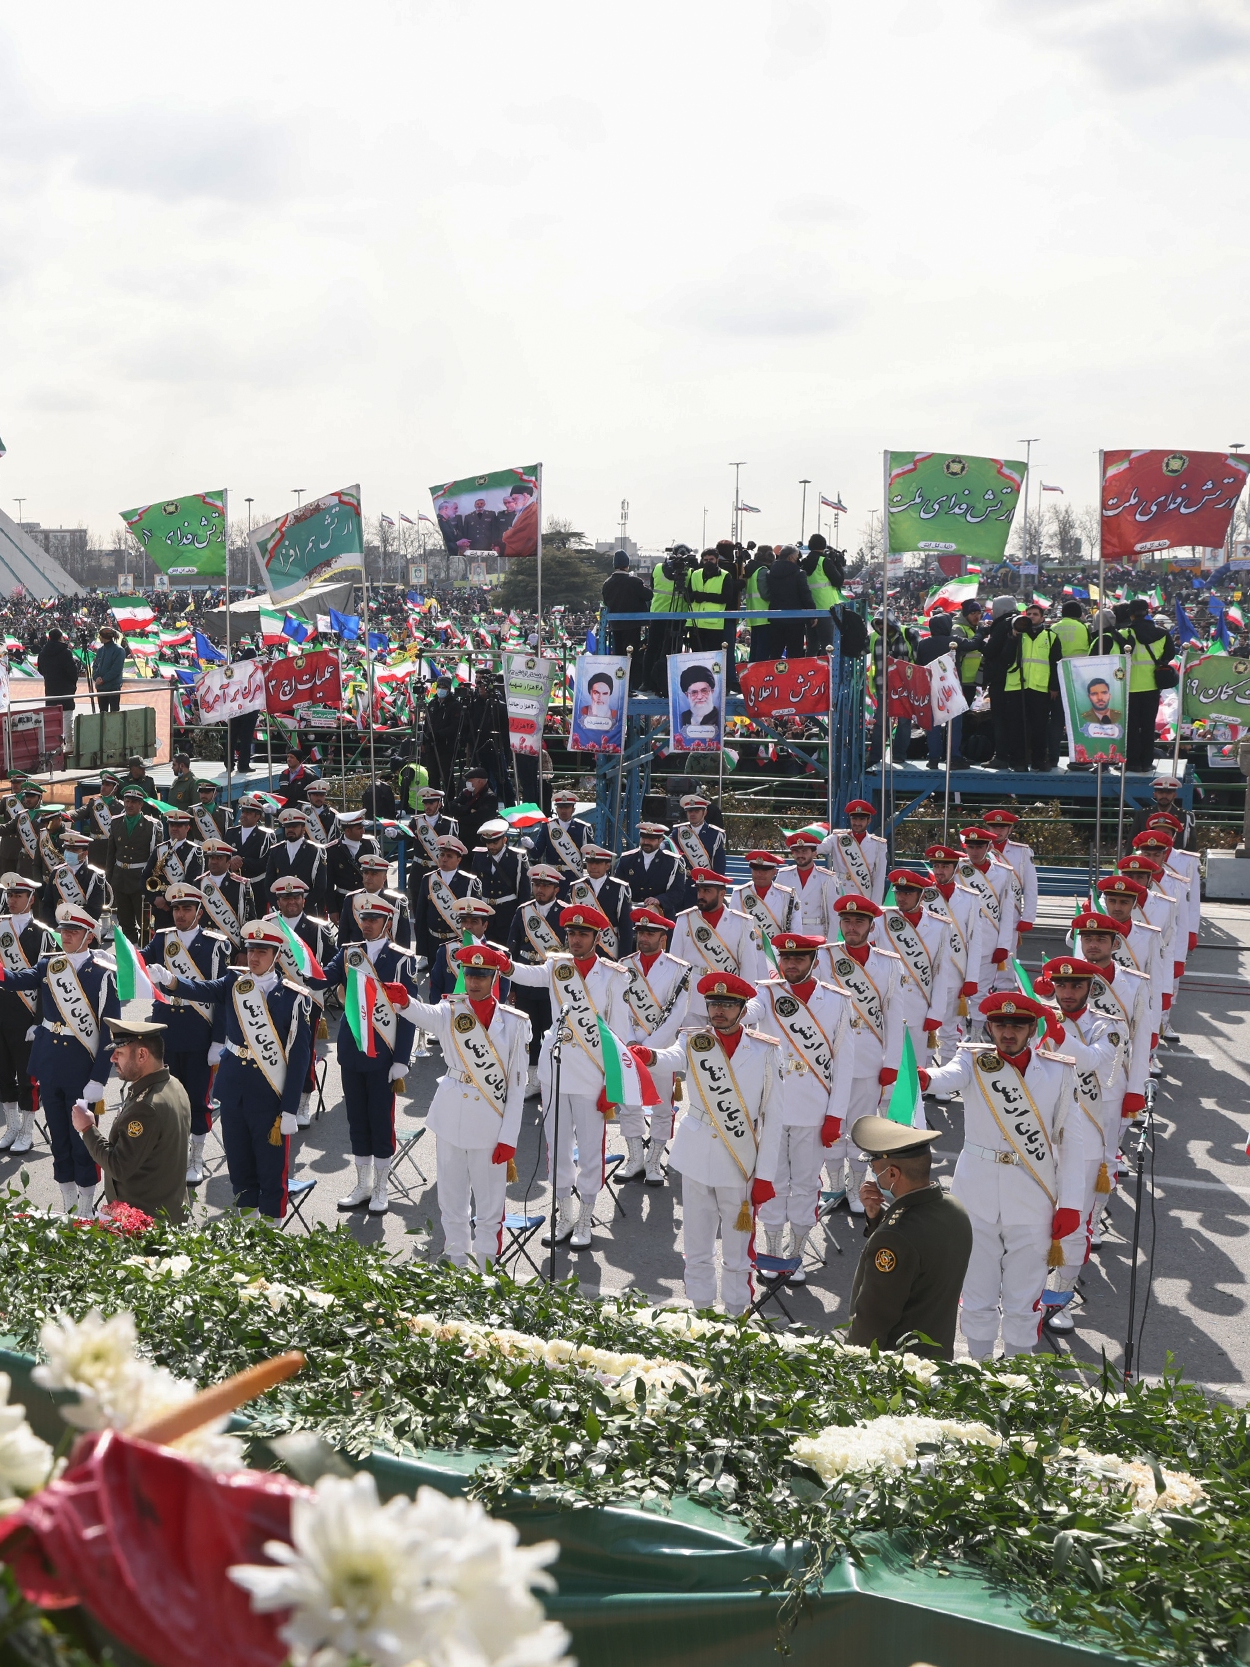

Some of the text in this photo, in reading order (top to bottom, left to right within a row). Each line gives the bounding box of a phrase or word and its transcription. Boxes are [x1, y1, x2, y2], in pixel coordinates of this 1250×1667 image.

[887, 486, 1016, 524] ارتش فدای ملت
[1102, 477, 1241, 522] ارتش فدای ملت
[194, 512, 226, 549] ارتش
[319, 506, 353, 550] ارتش
[279, 675, 296, 701] اچ
[297, 665, 335, 699] عملیات
[747, 670, 826, 711] ارتش انقلابی
[845, 849, 870, 890] دژبان ارتش
[970, 880, 994, 900] ارتش
[208, 897, 228, 918] ارتش
[704, 942, 728, 964] ارتش
[897, 933, 923, 957] ارتش
[57, 977, 93, 1038] دژبان ارتش
[629, 986, 658, 1016] ارتش
[845, 977, 878, 1005] ارتش
[373, 999, 390, 1027] دژبا
[564, 984, 600, 1048] دژبان ارتش
[243, 999, 278, 1067] دژبان ارتش
[789, 1021, 824, 1051] ارتش
[464, 1037, 496, 1070] ارتش
[700, 1058, 745, 1138] دژبان ارتش
[1078, 1070, 1098, 1101] دژبا
[991, 1079, 1045, 1161] دژبان ارتش
